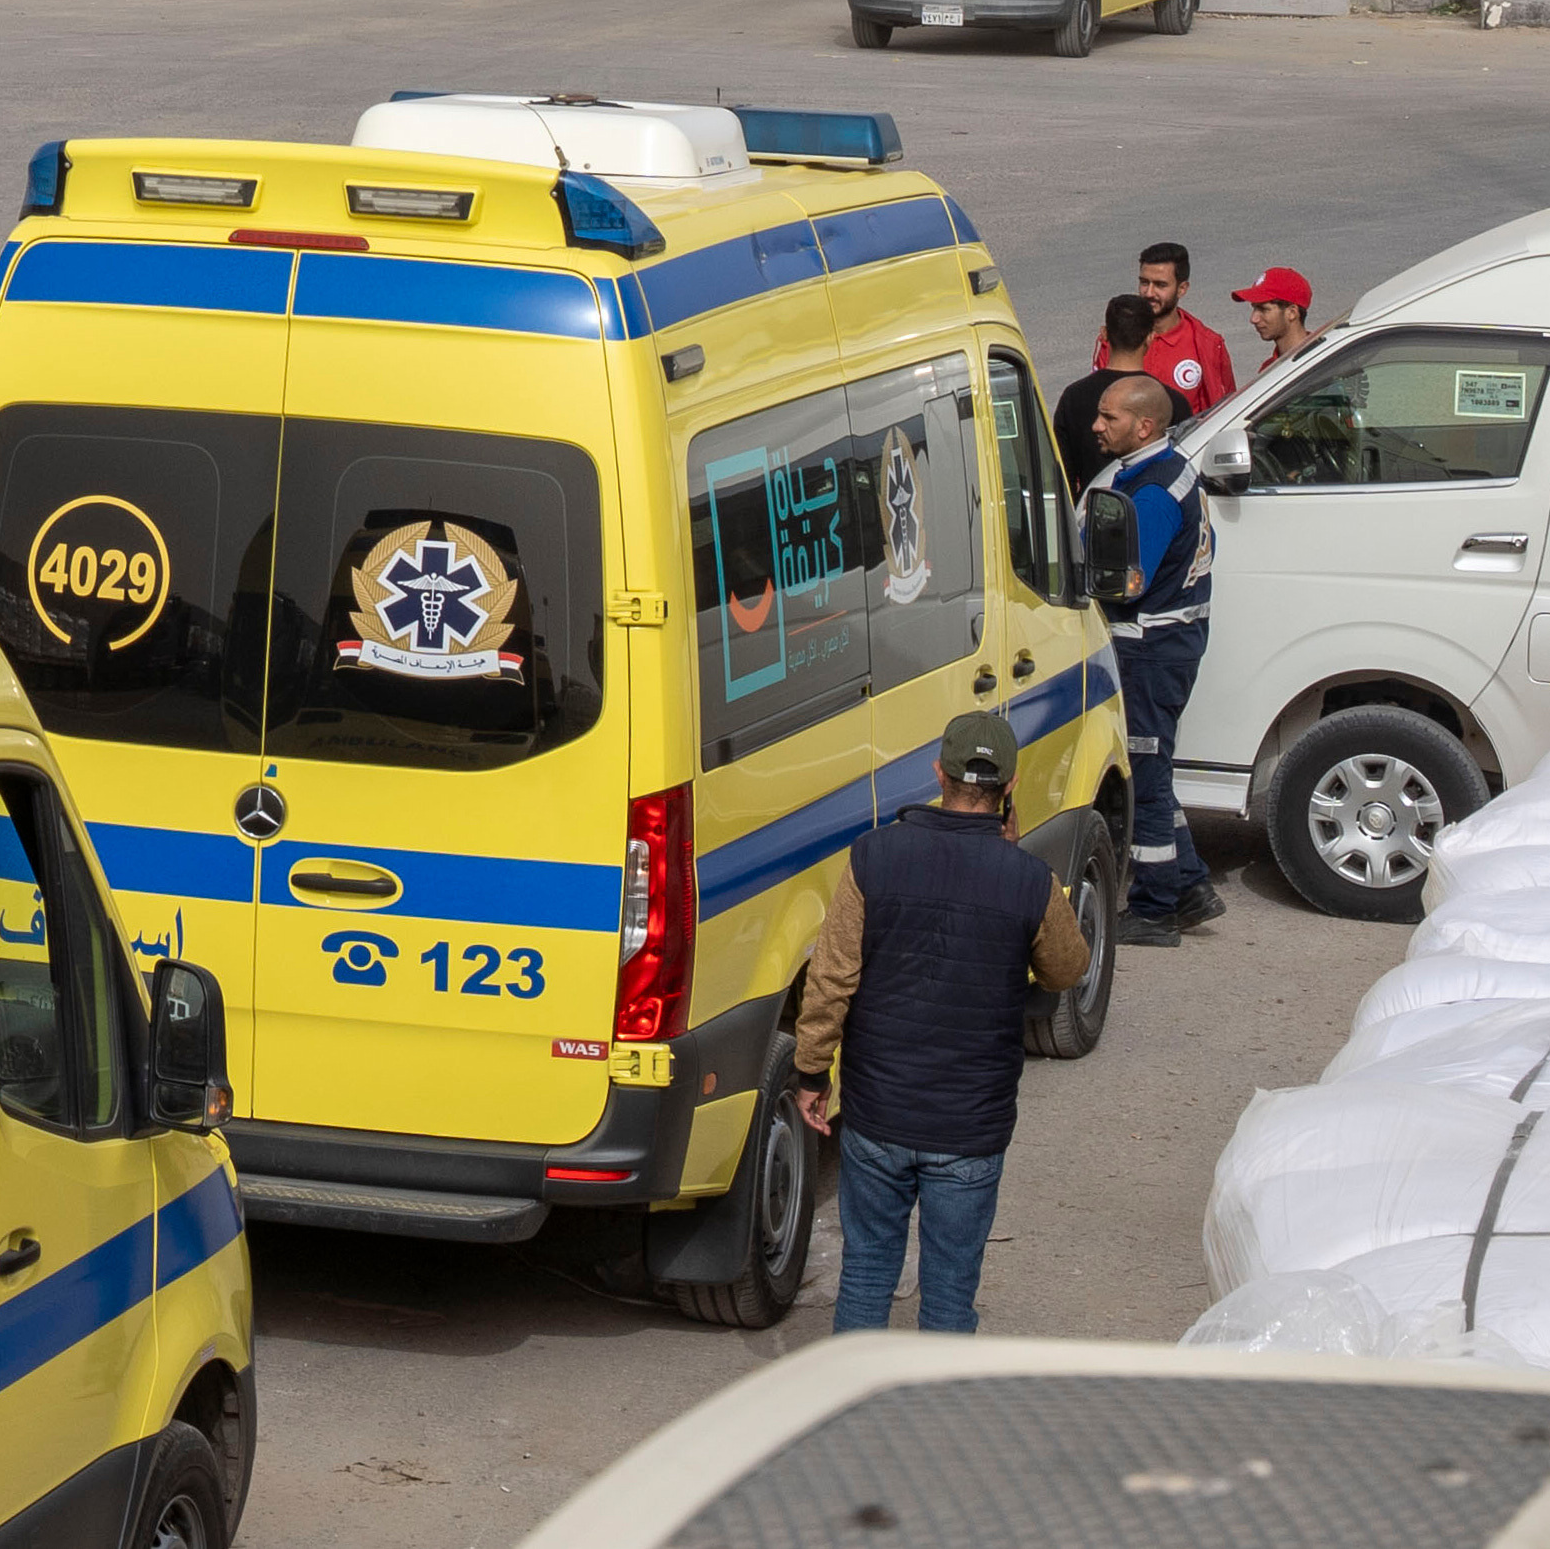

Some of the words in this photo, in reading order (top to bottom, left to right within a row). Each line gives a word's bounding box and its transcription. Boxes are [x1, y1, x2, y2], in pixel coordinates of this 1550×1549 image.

[772, 446, 840, 533] حياة
[40, 543, 156, 603] 4029
[781, 509, 845, 609] كريمة
[371, 644, 407, 665] المصرية
[421, 941, 546, 999] 123
[559, 1041, 601, 1056] WAS
